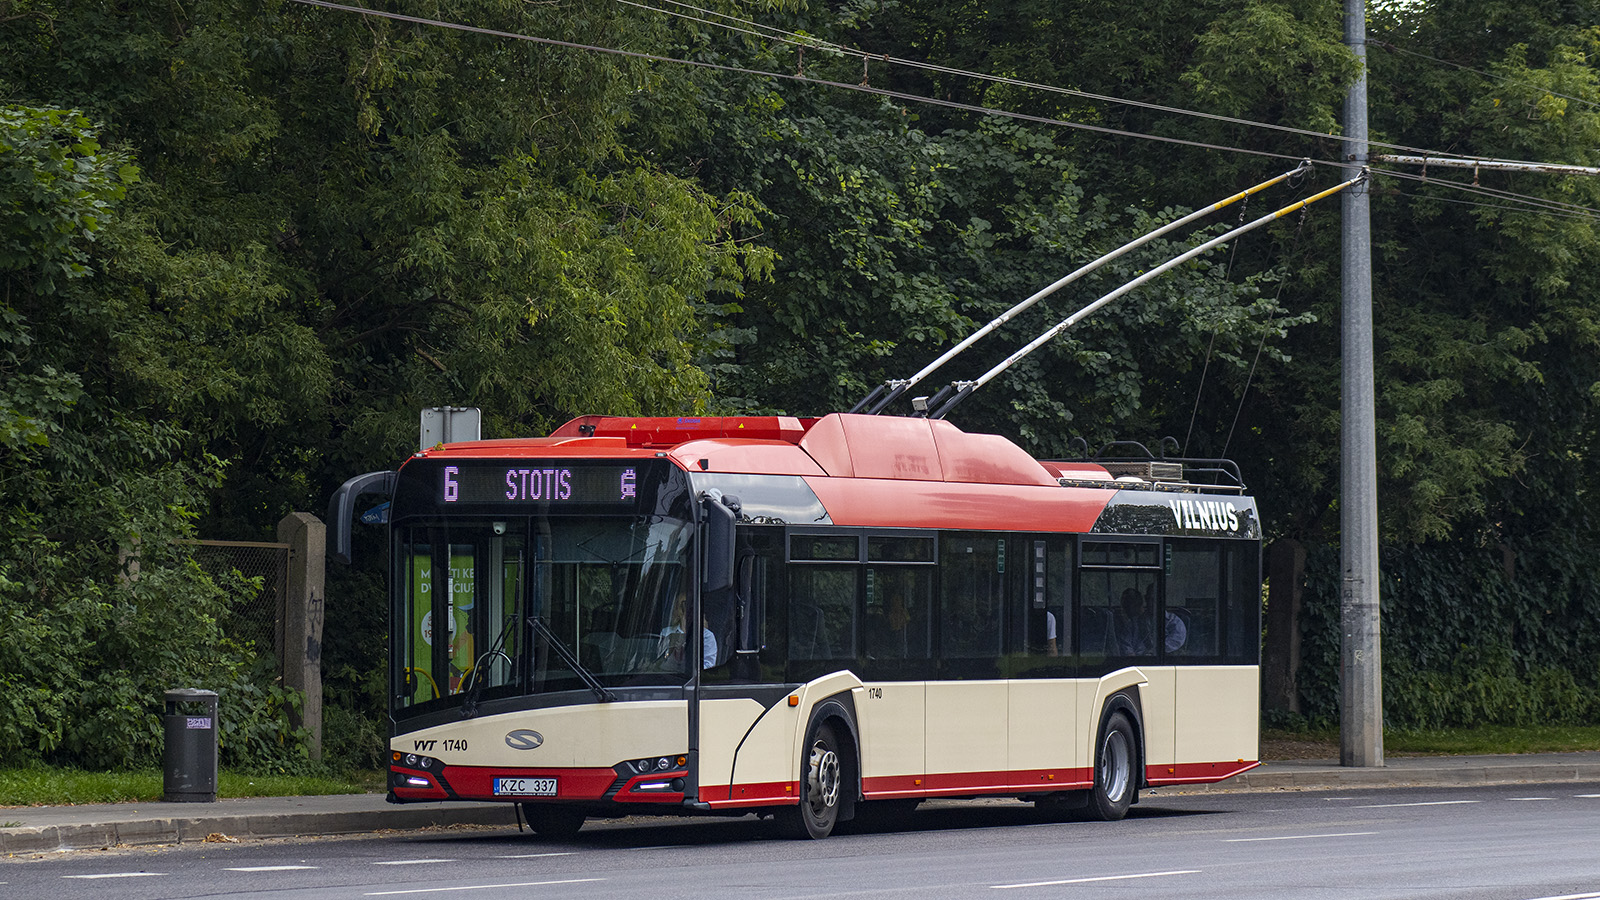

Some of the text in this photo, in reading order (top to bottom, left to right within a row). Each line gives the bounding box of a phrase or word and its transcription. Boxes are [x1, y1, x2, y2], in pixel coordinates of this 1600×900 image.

[444, 466, 571, 502] 6 STOTIS
[1168, 499, 1239, 531] VILNIUS
[869, 688, 883, 699] 1740
[443, 739, 468, 751] 1740
[501, 780, 555, 792] KZC 337
